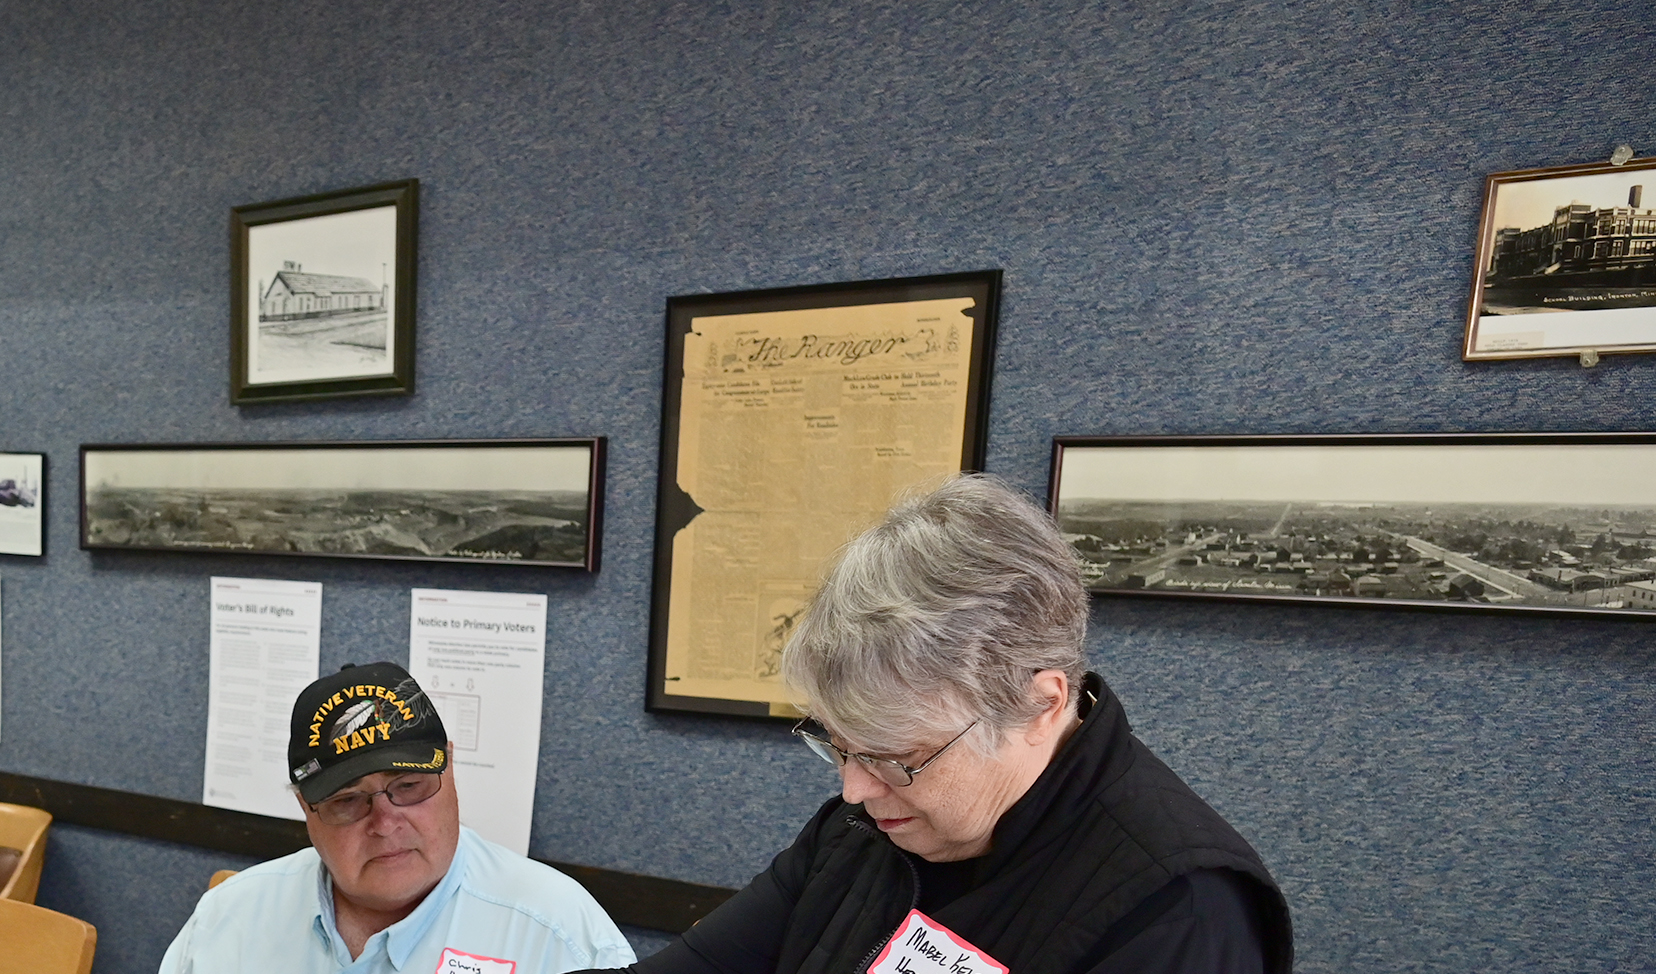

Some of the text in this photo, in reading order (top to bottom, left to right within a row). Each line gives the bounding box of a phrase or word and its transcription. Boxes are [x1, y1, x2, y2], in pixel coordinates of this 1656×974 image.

[748, 334, 906, 366] The Ranger
[215, 602, 295, 618] Voter's Bill of Rights
[417, 617, 536, 635] Notice to Primary Voters
[308, 684, 415, 747] NATIVE VETERAN
[332, 723, 392, 755] NAVY
[905, 926, 947, 967] MABEL
